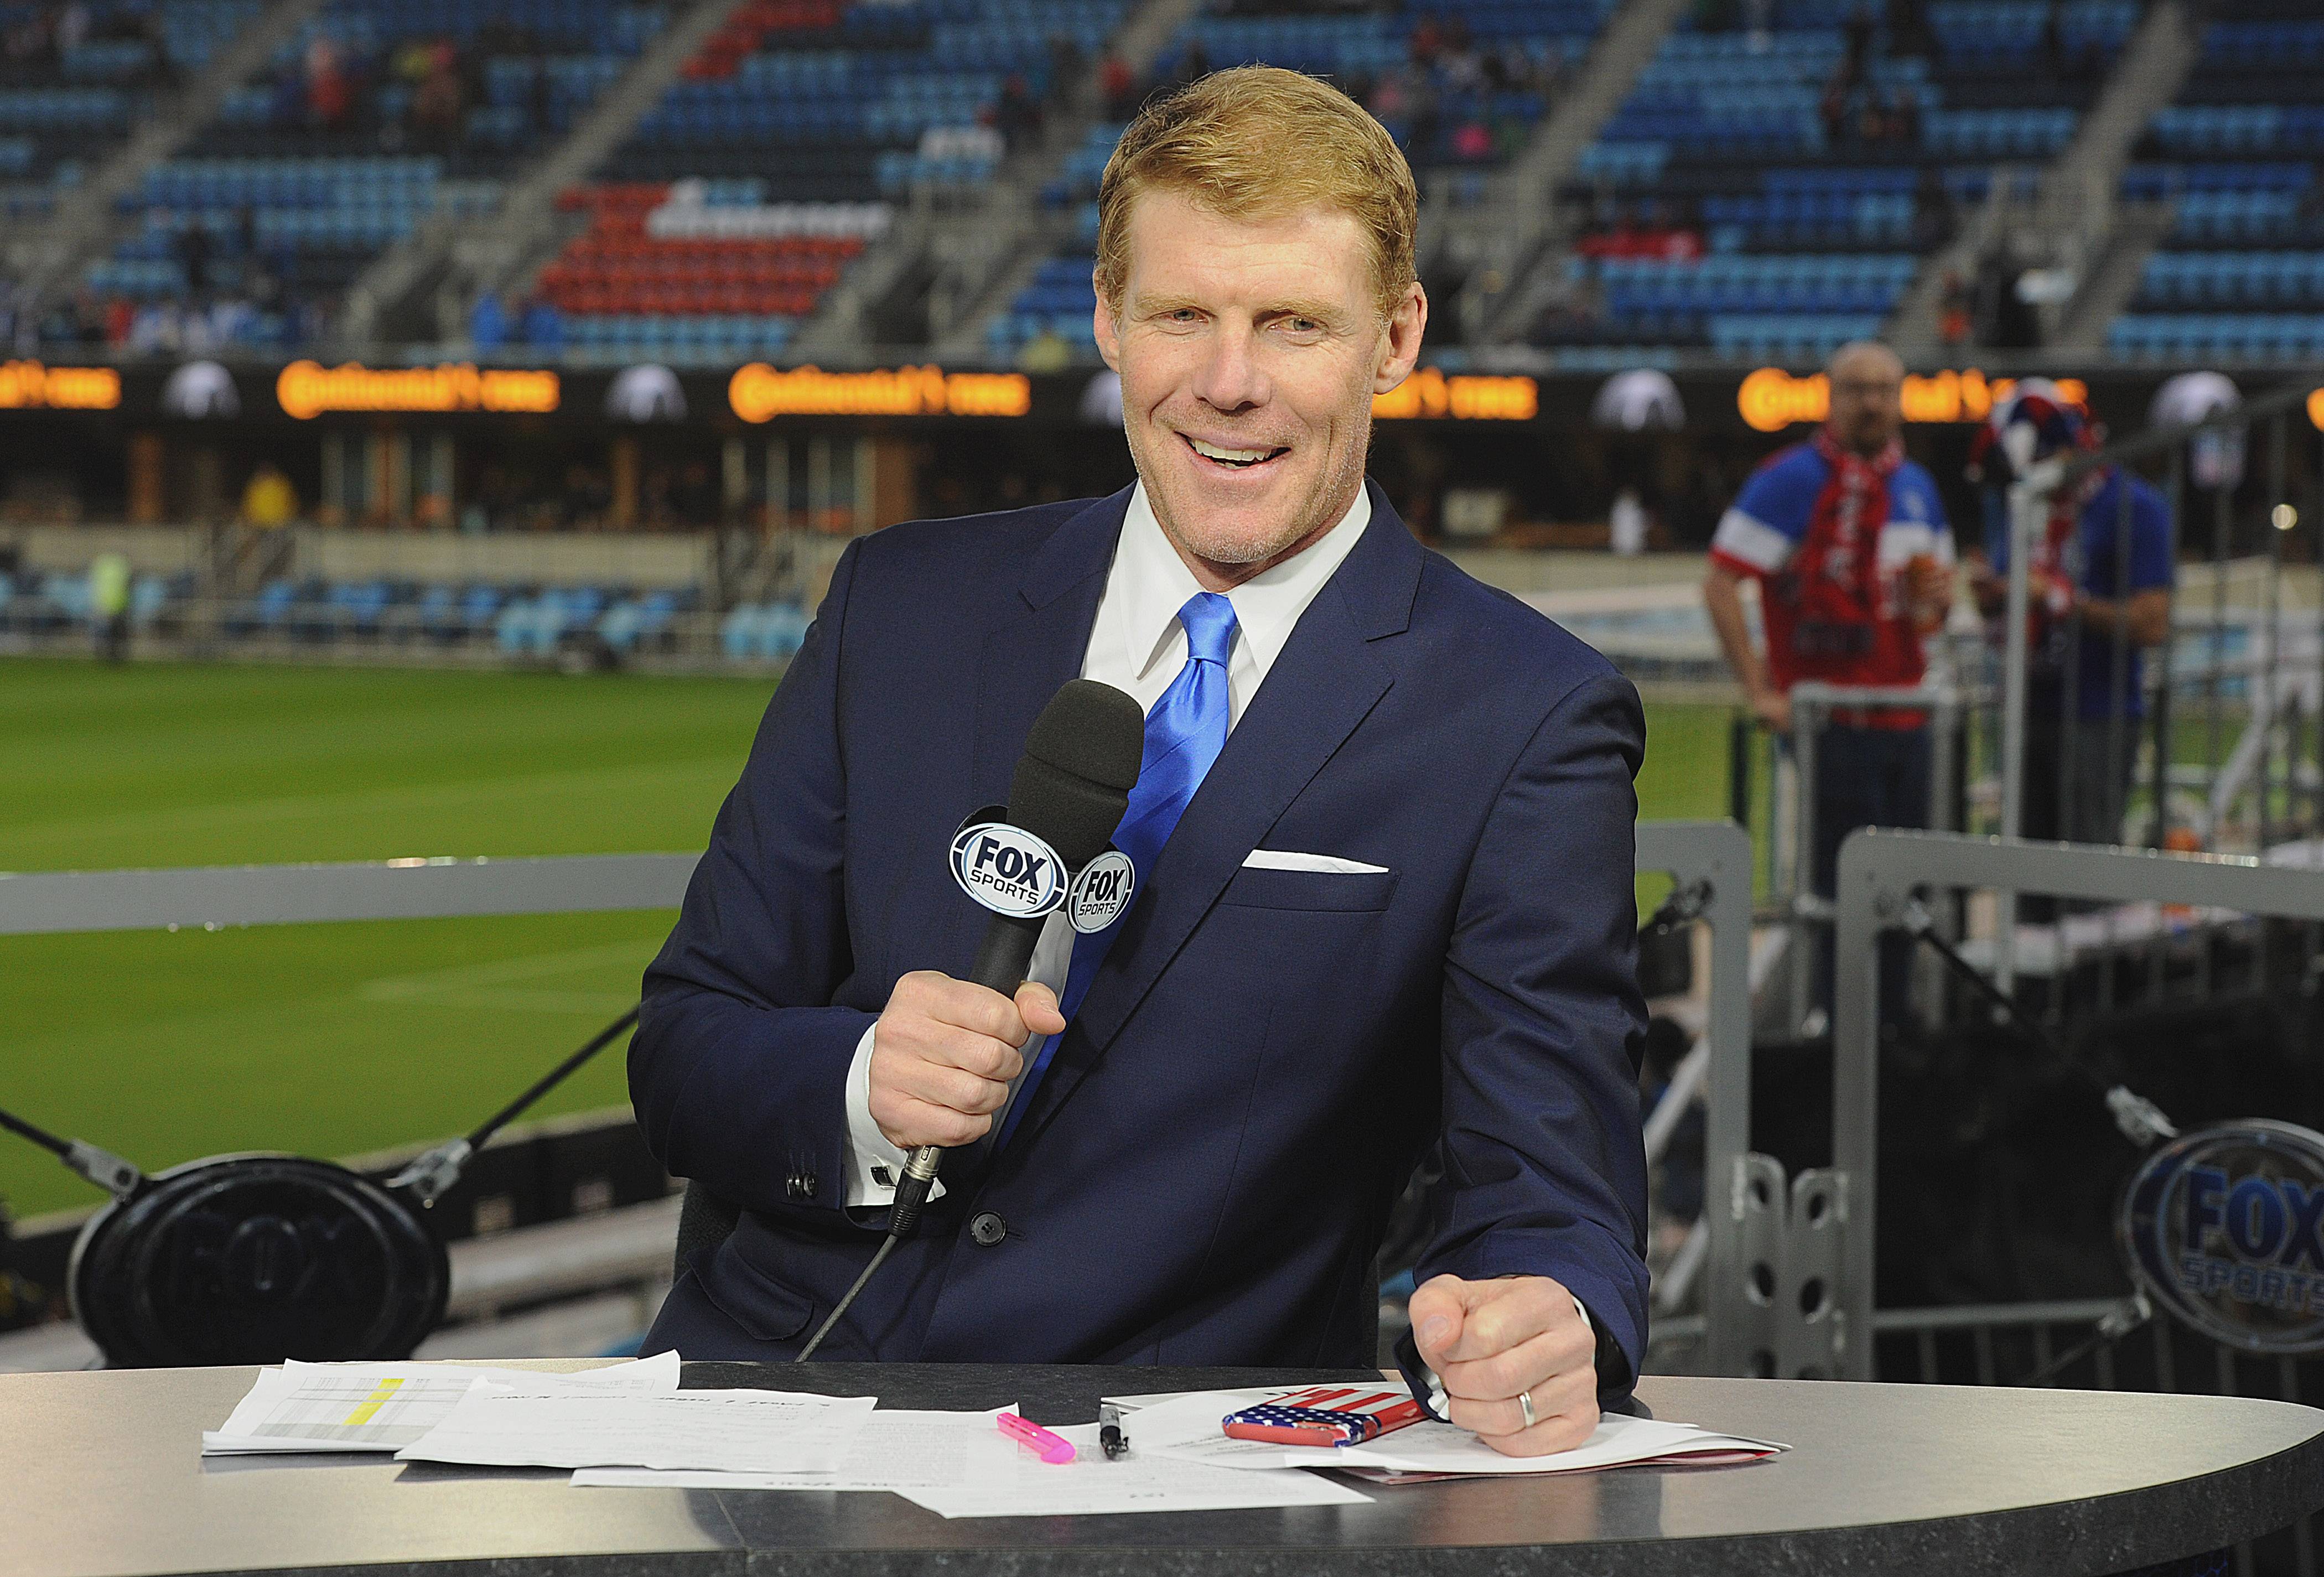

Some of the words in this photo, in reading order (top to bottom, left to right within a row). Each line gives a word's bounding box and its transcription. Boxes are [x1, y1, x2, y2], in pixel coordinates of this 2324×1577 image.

[974, 836, 1047, 891] FOX
[970, 869, 1039, 905] SPORTS
[1083, 869, 1125, 902] FOX
[1078, 902, 1116, 916] SPORTS
[2187, 1166, 2324, 1270] FOX
